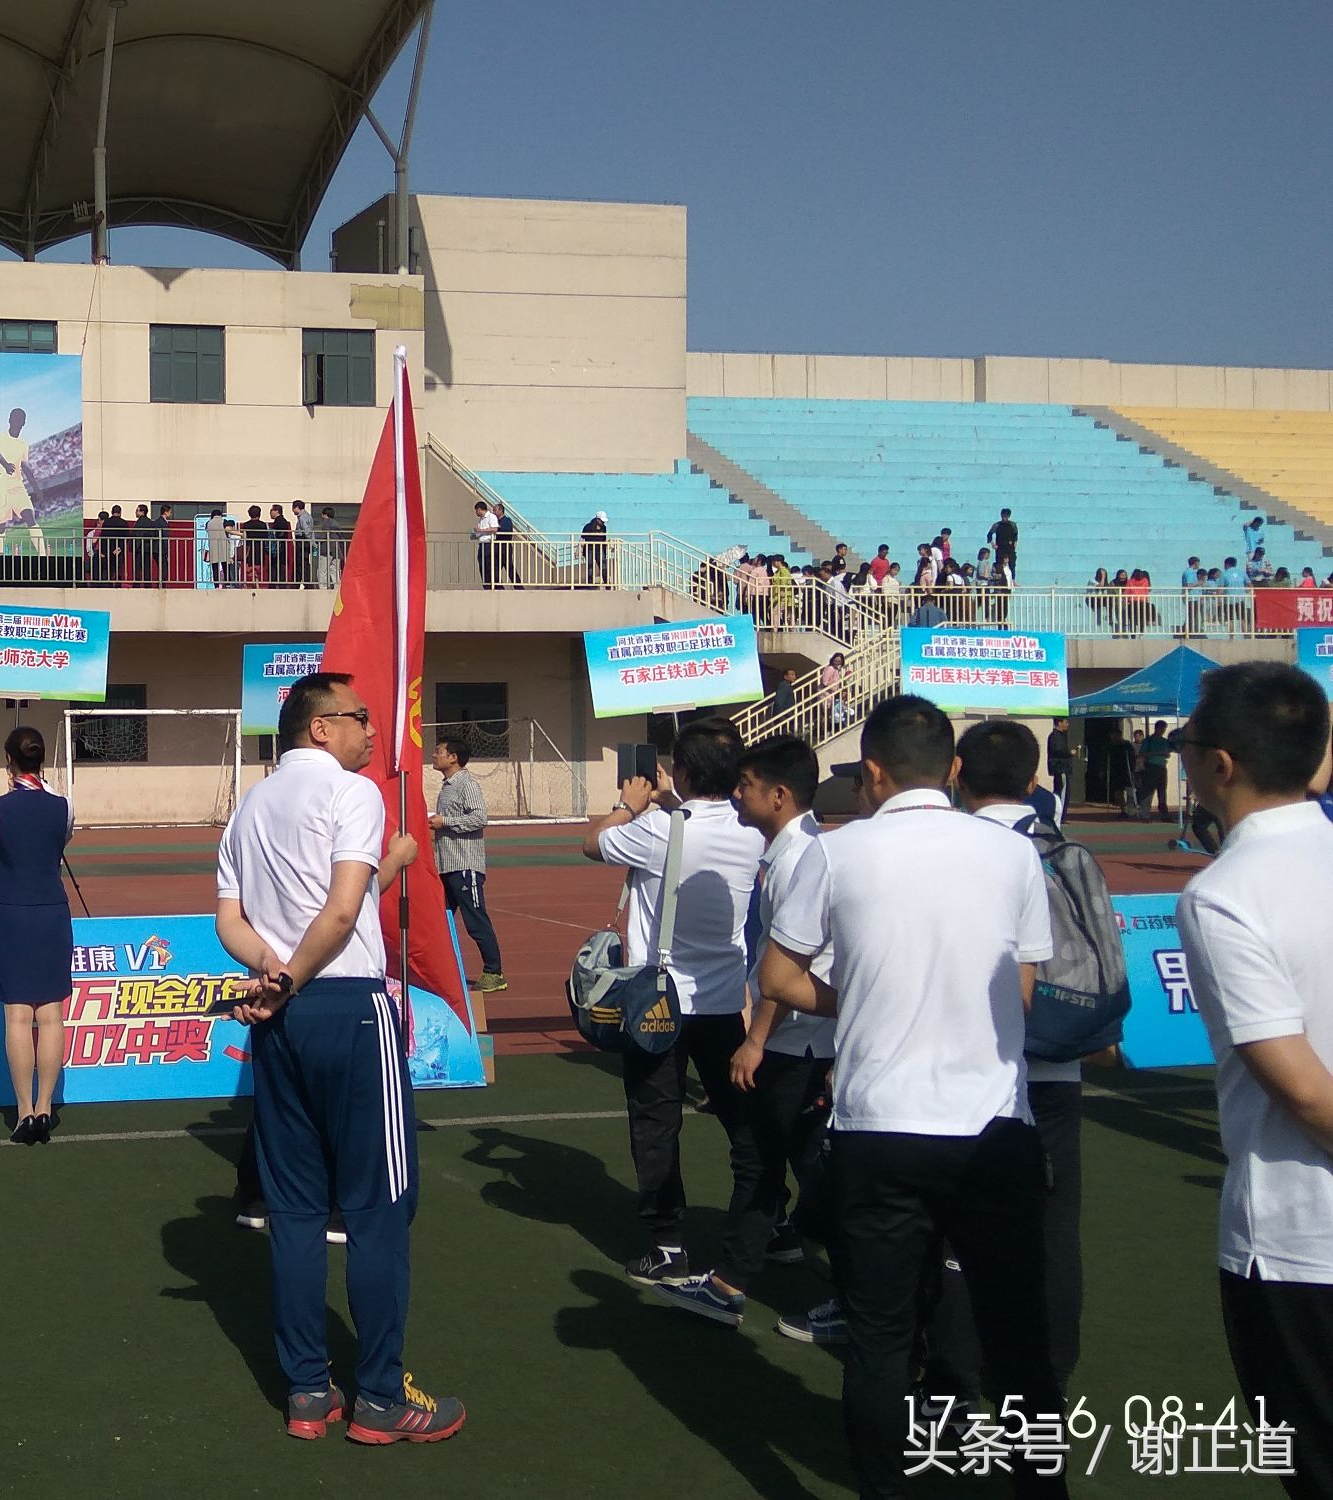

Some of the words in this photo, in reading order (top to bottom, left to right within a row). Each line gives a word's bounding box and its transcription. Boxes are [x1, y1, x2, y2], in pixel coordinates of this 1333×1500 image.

[265, 664, 320, 675] 直属高校教
[620, 658, 730, 685] 石家庄铁道大学
[911, 667, 1059, 687] 河北医科大学第二医院
[125, 944, 166, 971] V1
[639, 1020, 676, 1033] adidas
